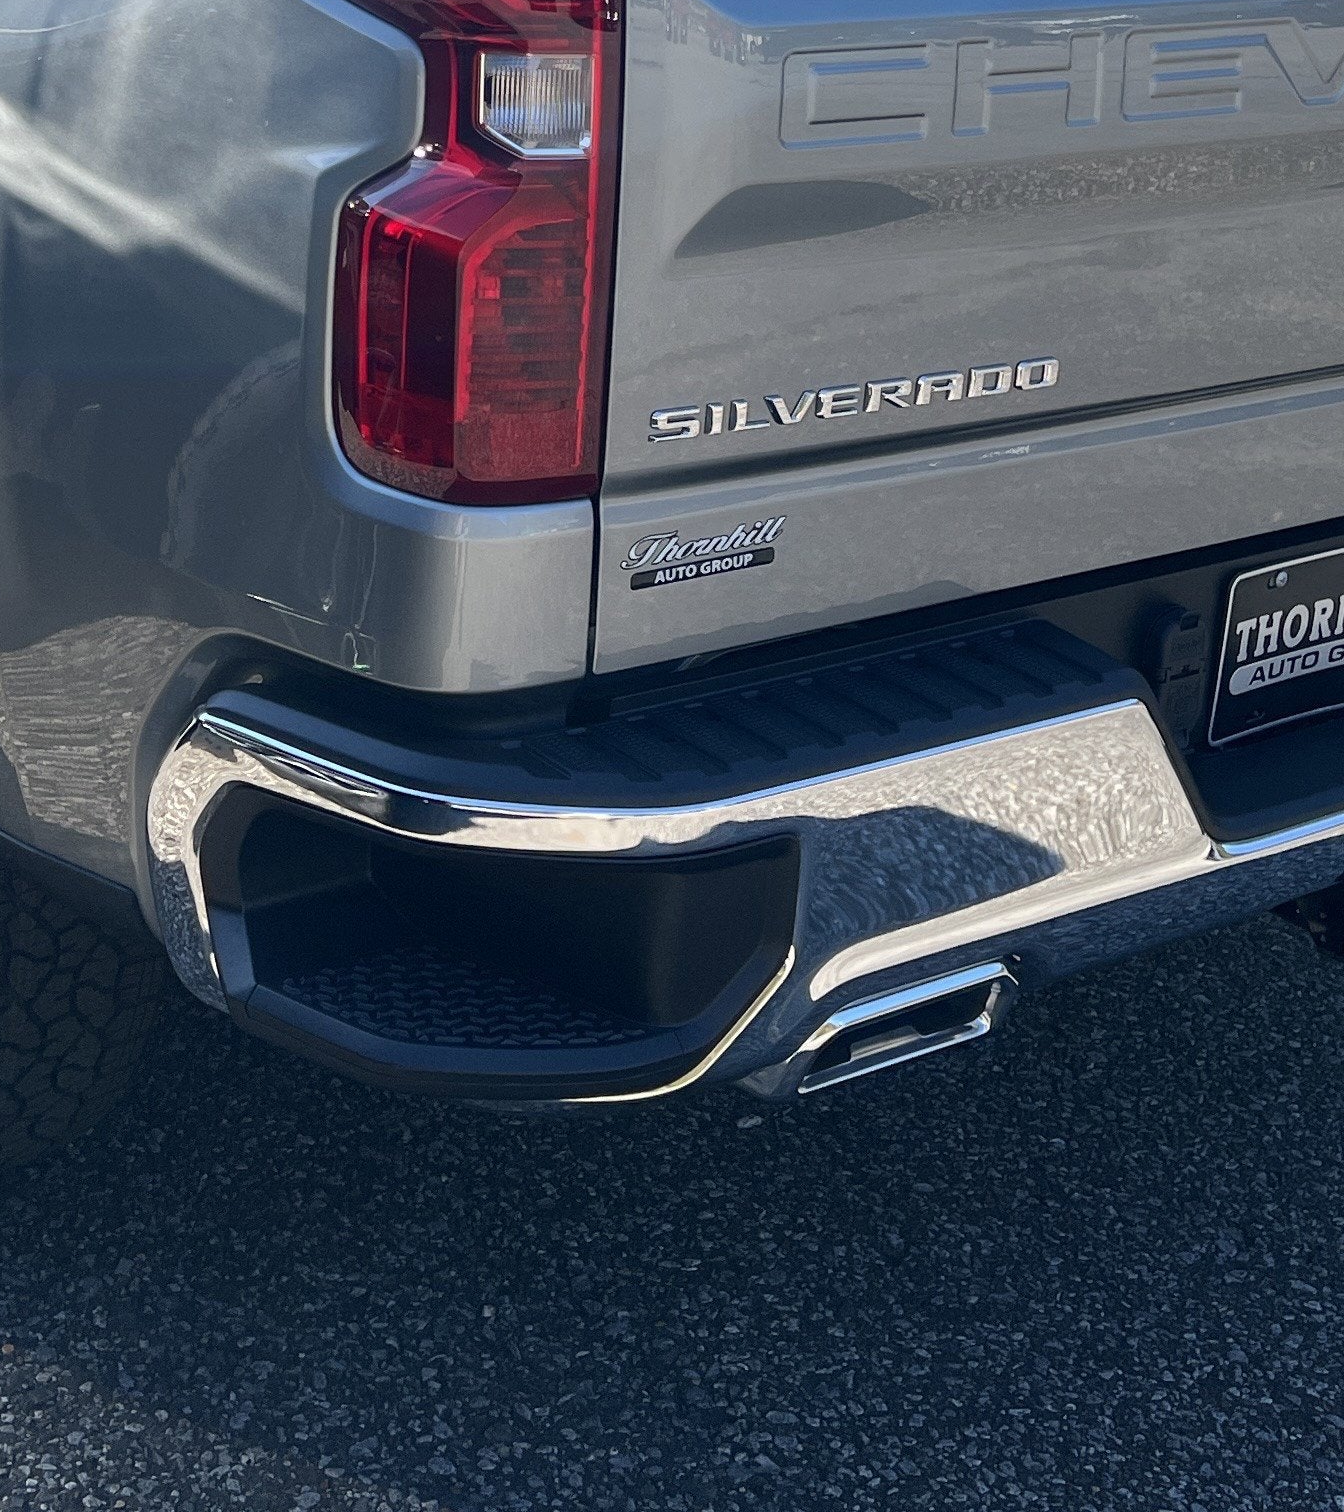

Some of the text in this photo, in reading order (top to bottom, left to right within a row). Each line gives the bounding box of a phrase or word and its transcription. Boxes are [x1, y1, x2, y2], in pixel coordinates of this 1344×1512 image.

[648, 355, 1060, 443] SILVERADO
[620, 515, 786, 570] Thornhill
[654, 553, 754, 586] AUTO GROUP
[1248, 650, 1319, 687] AUTO
